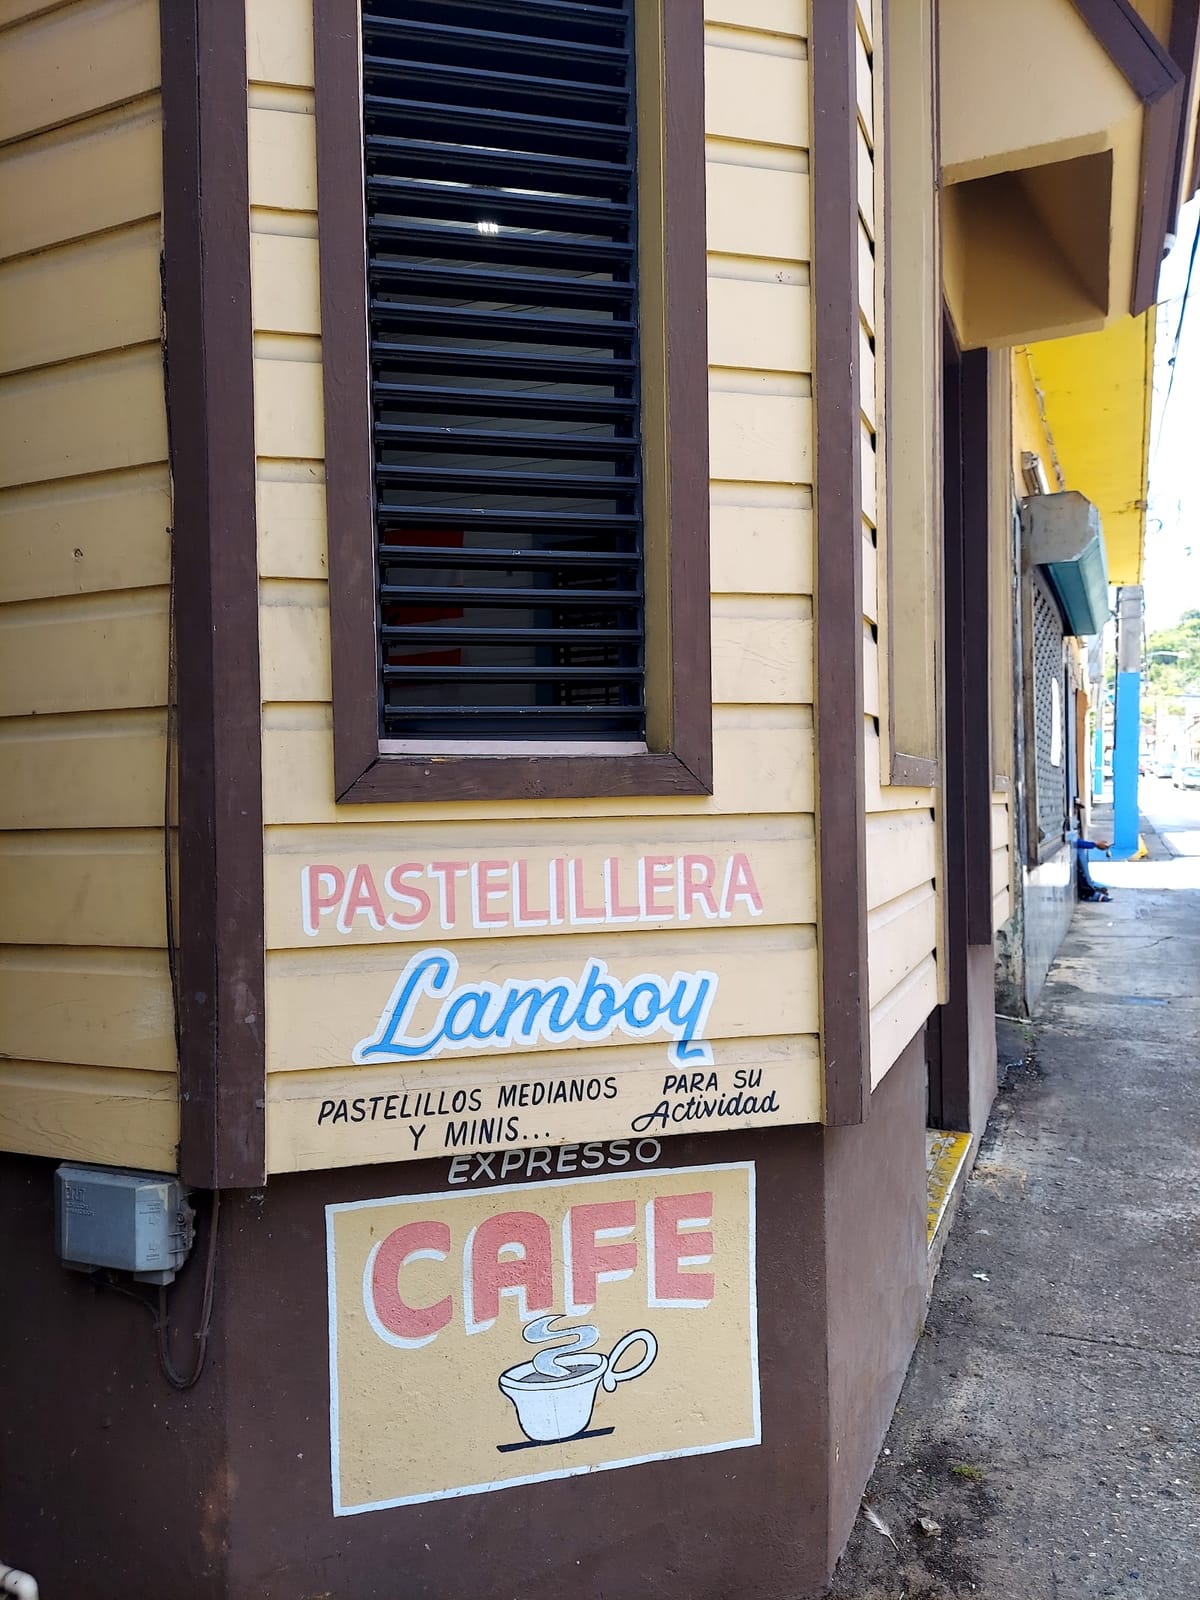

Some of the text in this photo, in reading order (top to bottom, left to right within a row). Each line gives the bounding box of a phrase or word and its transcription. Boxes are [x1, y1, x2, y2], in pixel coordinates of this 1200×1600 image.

[301, 853, 764, 936] PASTELILLERA
[352, 948, 719, 1069] Lamboy
[318, 1076, 619, 1126] PASTELILLOS MEDIANOS
[662, 1068, 762, 1095] PARA SU
[408, 1117, 551, 1152] Y MINIS...
[631, 1091, 780, 1133] Actividad
[447, 1138, 662, 1184] EXPRESSO
[363, 1191, 715, 1350] CAFE
